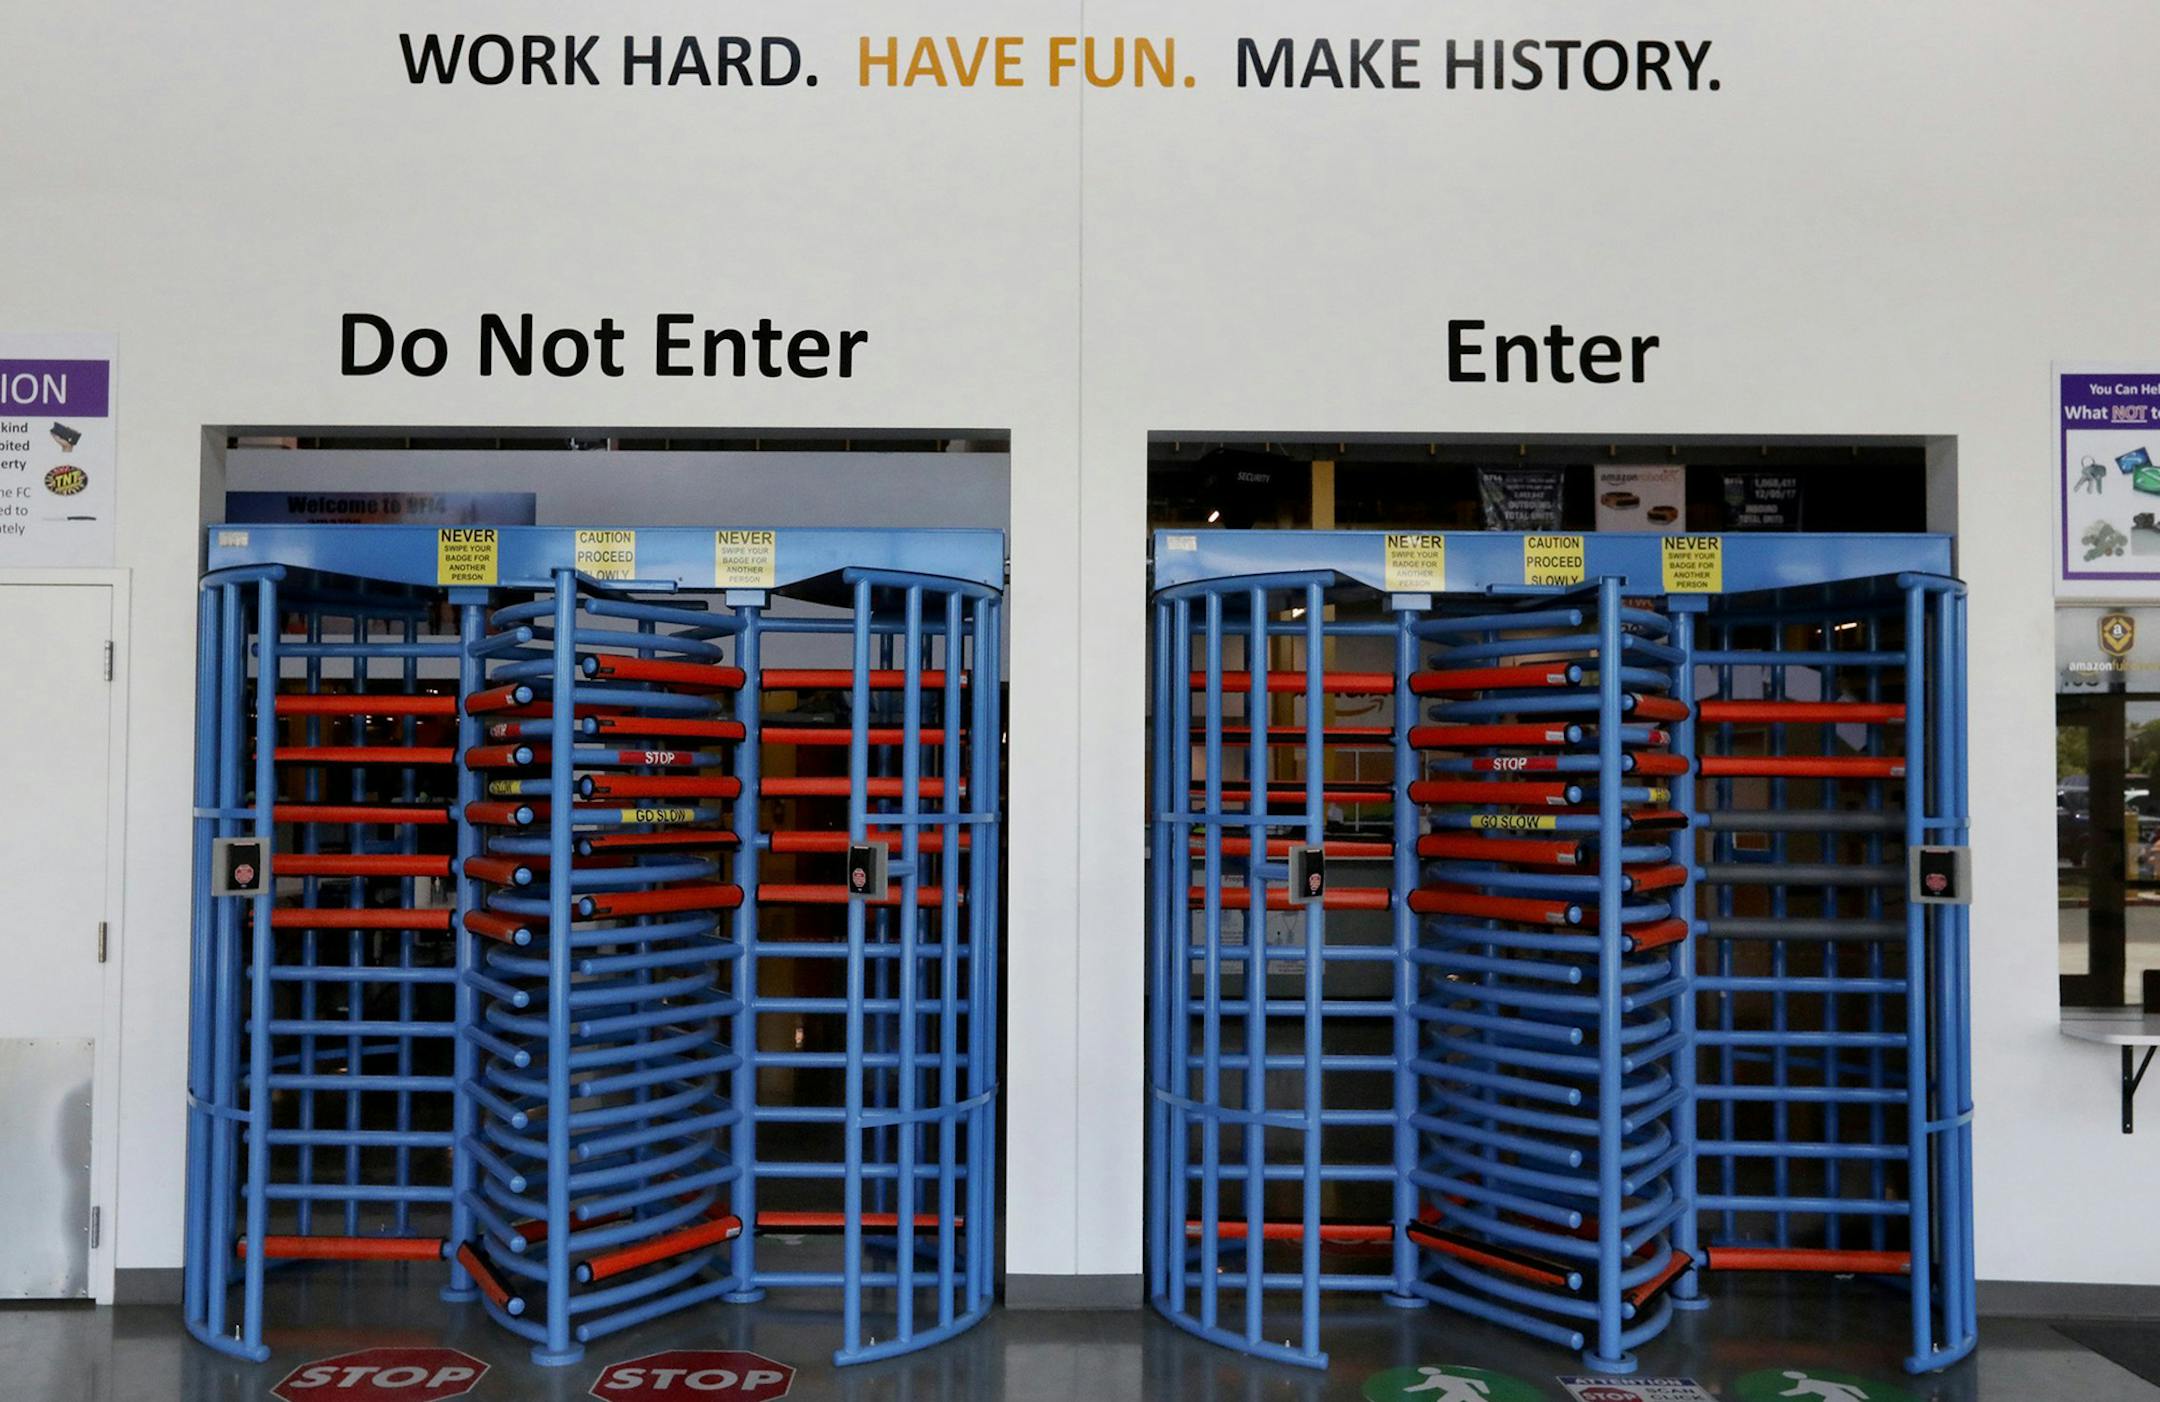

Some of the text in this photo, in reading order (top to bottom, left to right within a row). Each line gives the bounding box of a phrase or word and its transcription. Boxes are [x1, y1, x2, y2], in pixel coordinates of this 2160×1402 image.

[399, 33, 1721, 91] WORK HARD. HAVE FUN. MAKE HISTORY.
[341, 313, 869, 378] Do Not Enter
[1448, 319, 1660, 384] Enter
[1, 373, 67, 405] ION
[2089, 383, 2112, 395] You
[2115, 383, 2138, 395] Can
[2064, 405, 2108, 420] What
[2111, 405, 2148, 422] NOT
[1, 421, 29, 433] kind
[16, 487, 32, 498] FC
[15, 506, 29, 516] to
[288, 496, 378, 513] Welcome
[383, 496, 401, 513] to
[441, 529, 495, 543] NEVER
[580, 531, 631, 543] CAUTION
[718, 531, 773, 545] NEVER
[1388, 535, 1442, 549] NEVER
[1528, 536, 1580, 549] CAUTION
[1664, 536, 1719, 550] NEVER
[578, 550, 633, 562] PROCEED
[1527, 556, 1583, 568] PROCEED
[1392, 560, 1437, 568] BADGE FOR
[451, 573, 483, 581] PERSON
[729, 575, 761, 583] PERSON
[1531, 575, 1579, 586] SLOWLY
[645, 752, 675, 764] STOP
[1493, 757, 1527, 770] STOP
[636, 809, 687, 822] GO SLOW
[1480, 816, 1540, 829] GO SLOW
[289, 1365, 476, 1389] STOP
[604, 1367, 782, 1390] STOP
[1575, 1378, 1682, 1386] ATTENTION
[1583, 1391, 1635, 1402] STOP
